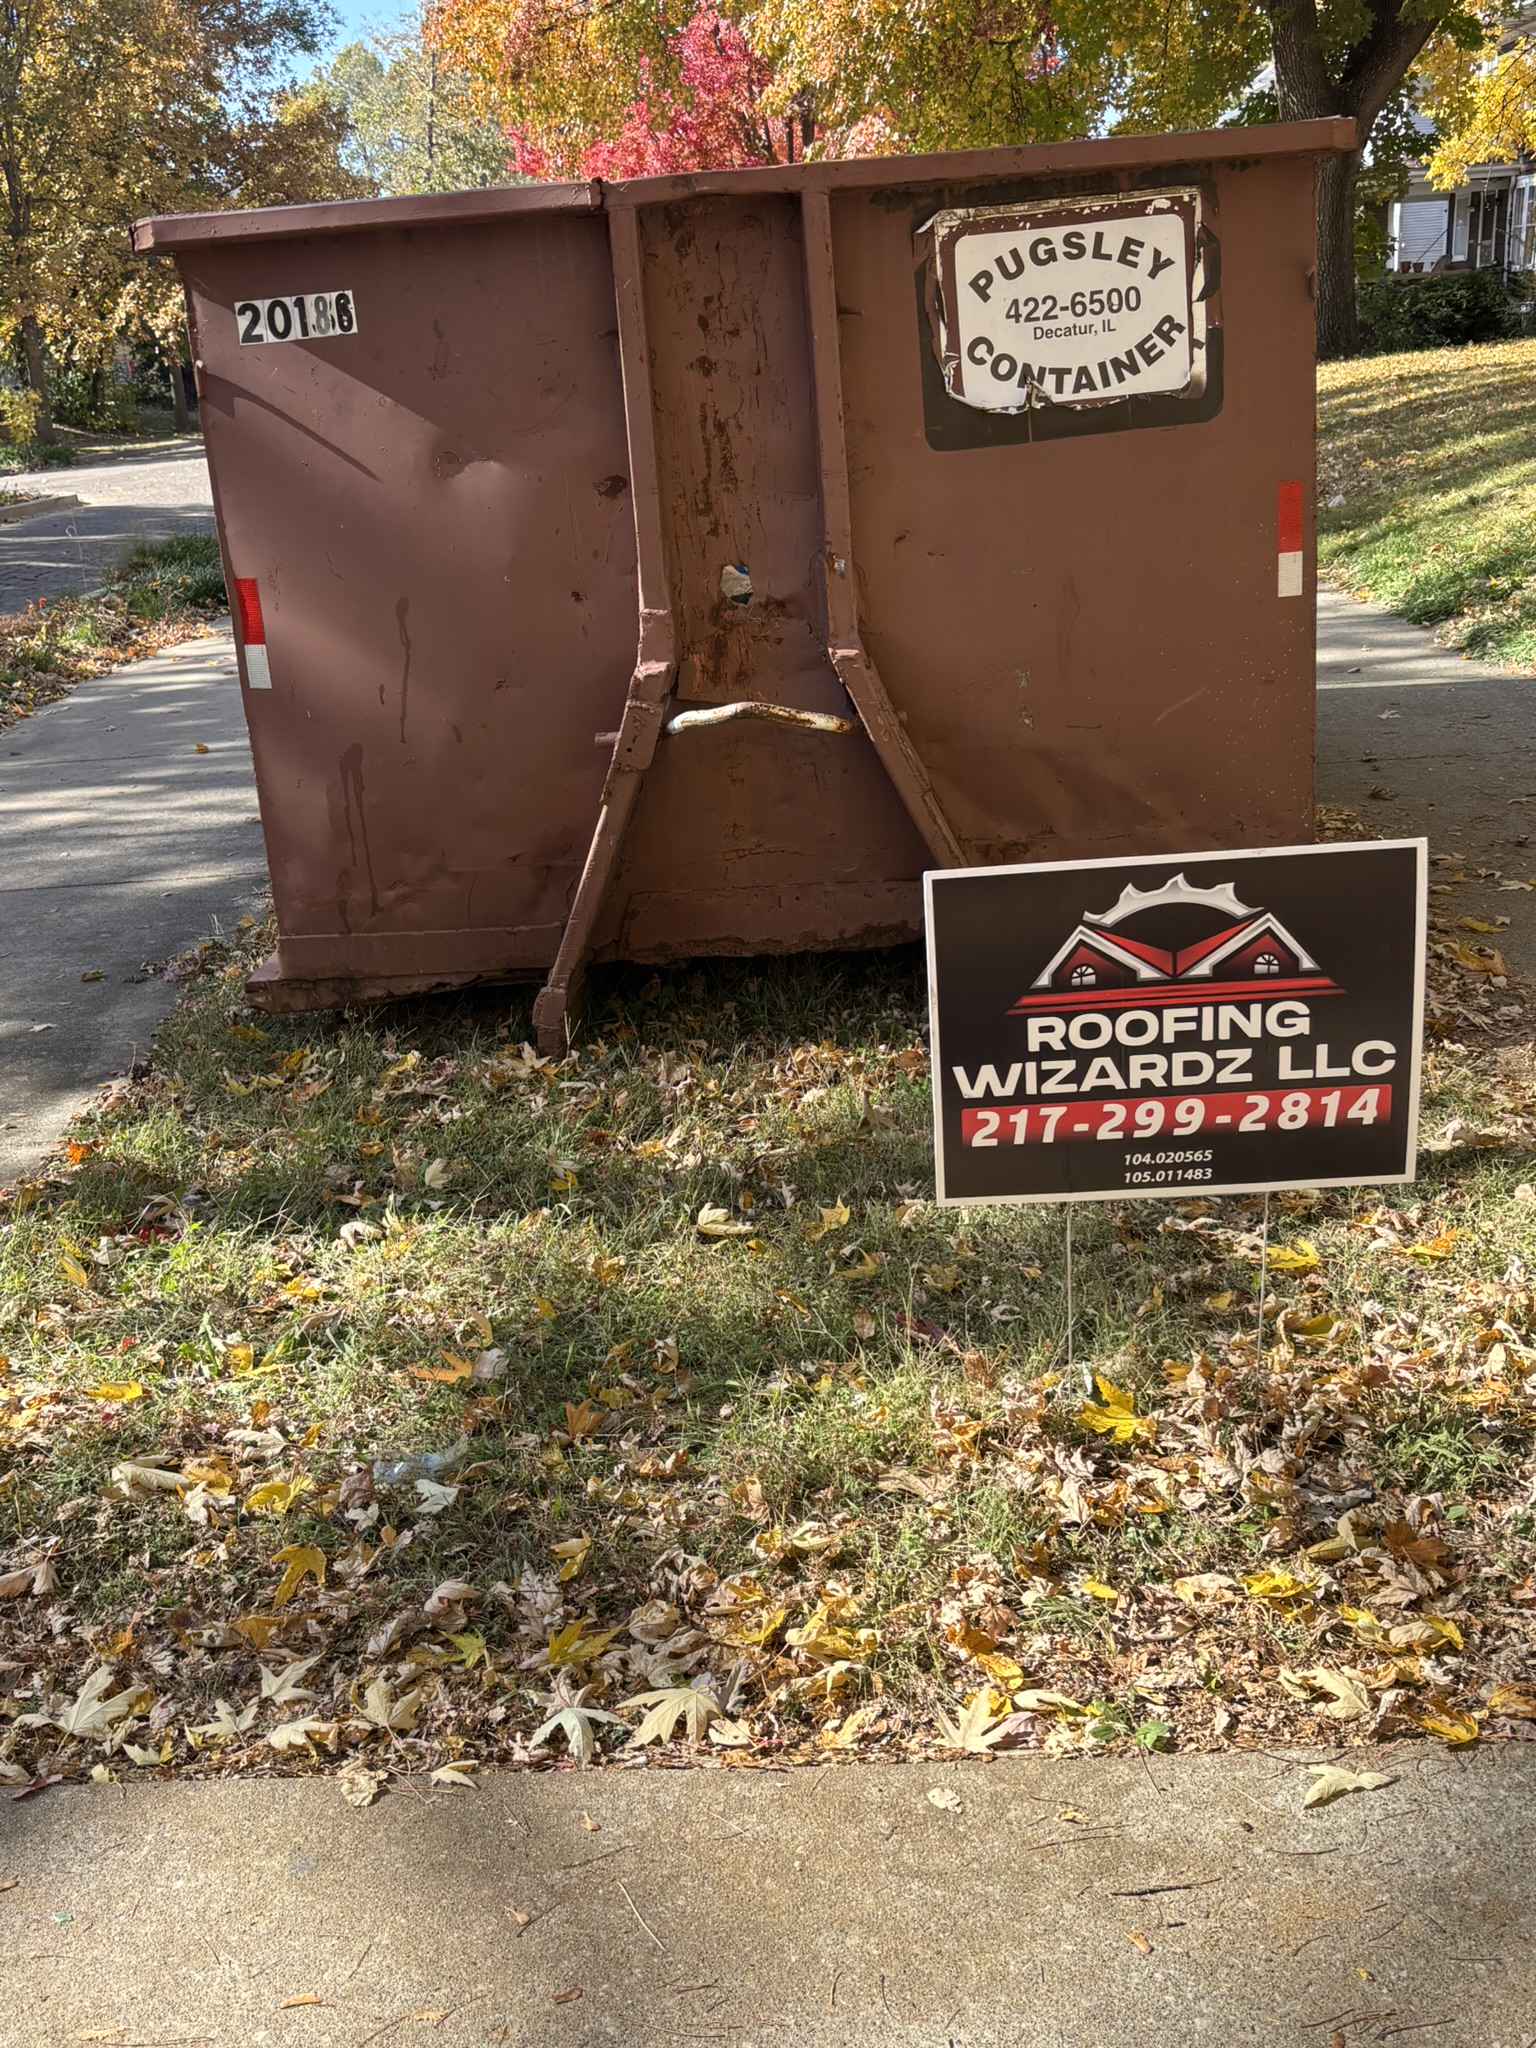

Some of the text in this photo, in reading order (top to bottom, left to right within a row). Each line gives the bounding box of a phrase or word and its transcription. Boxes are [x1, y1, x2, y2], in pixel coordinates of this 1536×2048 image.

[968, 231, 1175, 303] PUGSLEY
[1005, 285, 1142, 324] 422-6500
[1033, 319, 1116, 340] Decatur, IL
[967, 314, 1186, 395] CONTAINER
[1027, 1000, 1311, 1053] ROOFING
[952, 1040, 1396, 1099] WIZARDZ LLC
[971, 1088, 1381, 1148] 217-299-2814
[1124, 1149, 1213, 1166] 104.020565
[1124, 1168, 1213, 1184] 105.011483
